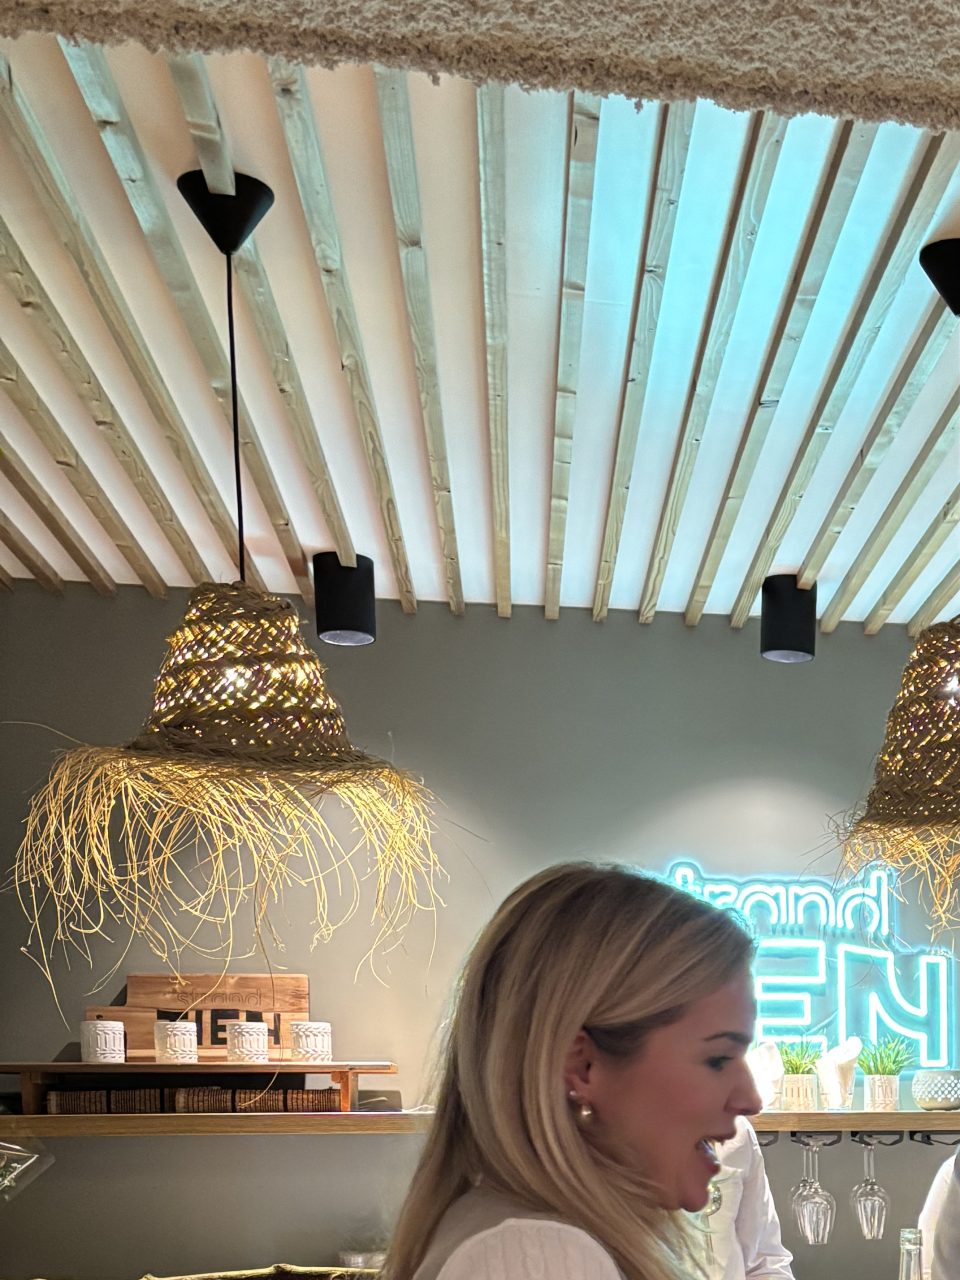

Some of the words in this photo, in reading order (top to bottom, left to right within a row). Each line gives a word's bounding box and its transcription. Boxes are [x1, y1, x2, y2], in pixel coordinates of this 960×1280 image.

[672, 865, 890, 936] trand
[176, 987, 262, 1007] strand
[752, 937, 949, 1068] EN
[156, 1008, 281, 1046] IEN
